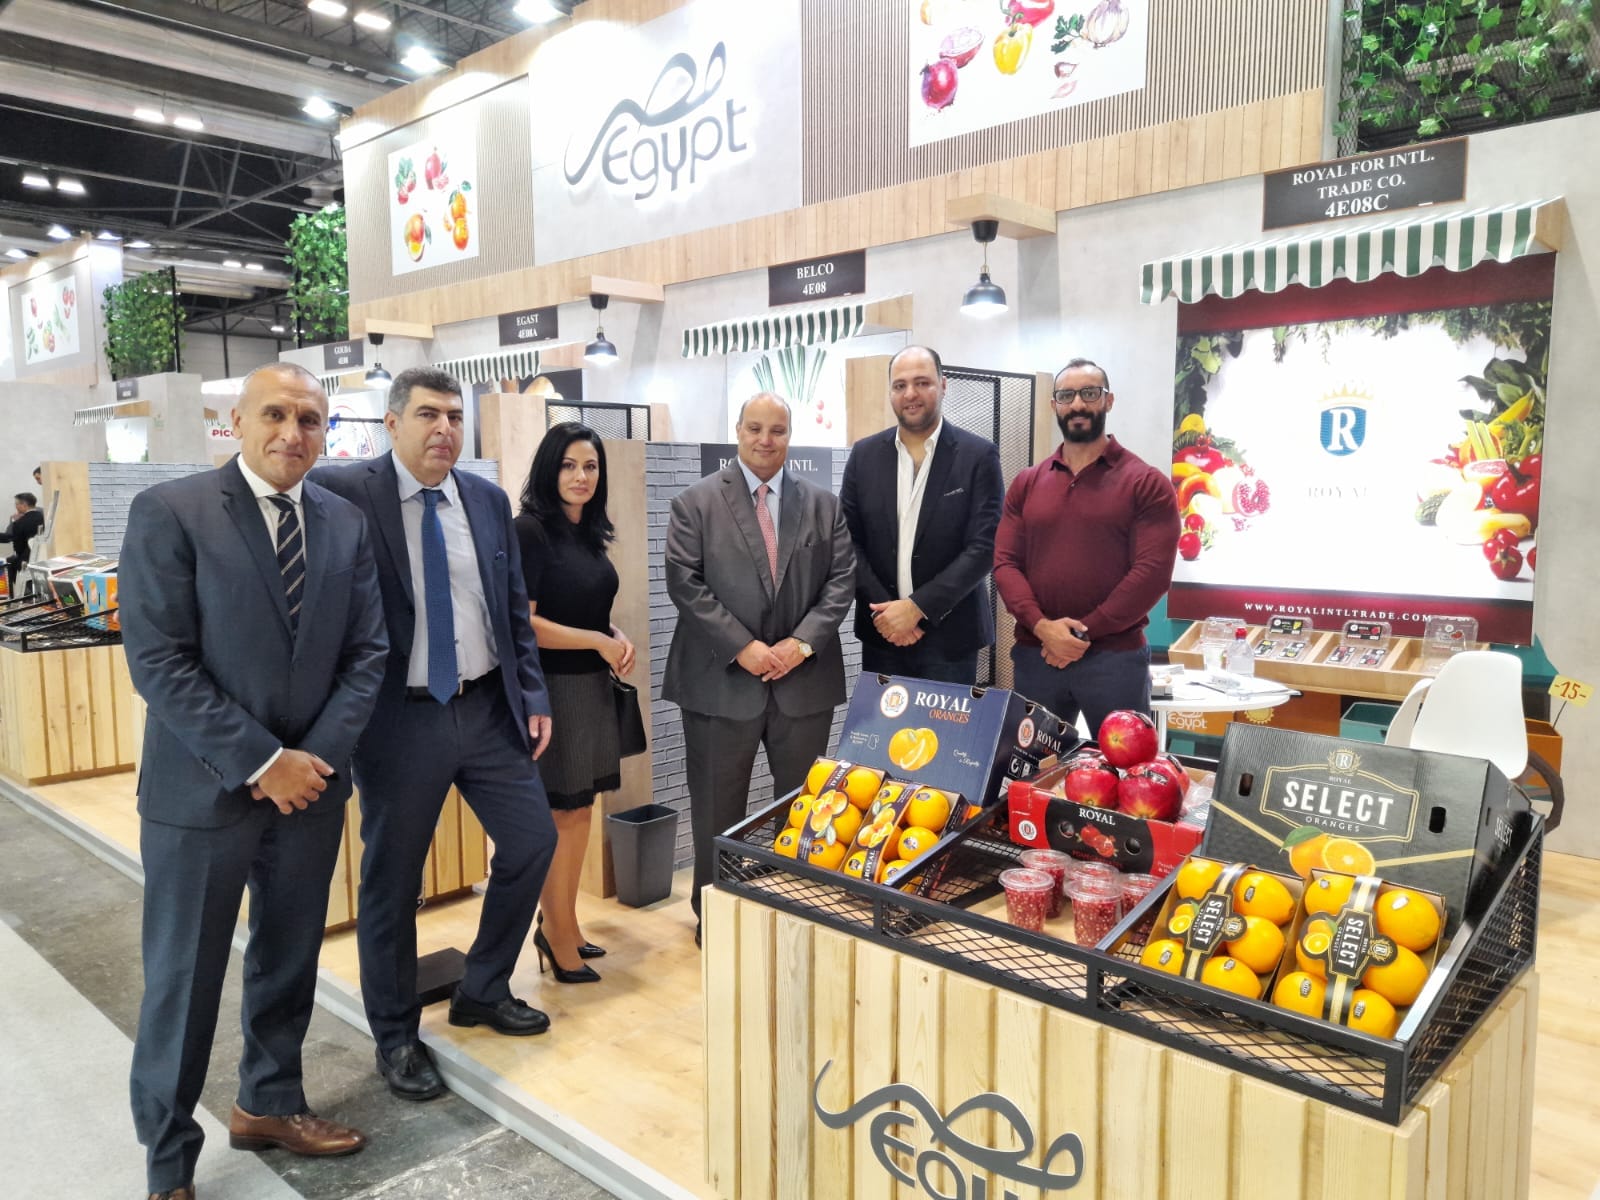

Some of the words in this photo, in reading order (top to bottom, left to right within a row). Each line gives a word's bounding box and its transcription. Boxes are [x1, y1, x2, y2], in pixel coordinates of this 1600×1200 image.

[602, 99, 747, 200] Egypt
[1292, 165, 1347, 185] ROYAL
[1351, 157, 1385, 174] FOR
[1389, 149, 1435, 168] INTL.
[1317, 179, 1373, 199] TRADE
[1377, 174, 1406, 189] CO.
[1325, 194, 1389, 218] 4E08C
[796, 262, 834, 279] BELCO
[802, 281, 827, 295] 4E08
[516, 313, 538, 326] EGAST
[212, 429, 233, 437] PIC
[1244, 602, 1432, 622] WWW.ROYALINTLTRADE.COM
[914, 691, 972, 713] ROYAL
[929, 708, 970, 724] ORANGES
[1167, 711, 1208, 730] Egypt
[1037, 729, 1062, 753] ROYAL
[1283, 781, 1393, 825] SELECT
[1079, 808, 1116, 826] ROYAL
[1305, 815, 1360, 833] ORANGES
[1494, 815, 1513, 848] SELECT
[1195, 900, 1223, 944] SELECT
[1338, 917, 1364, 968] SELECT
